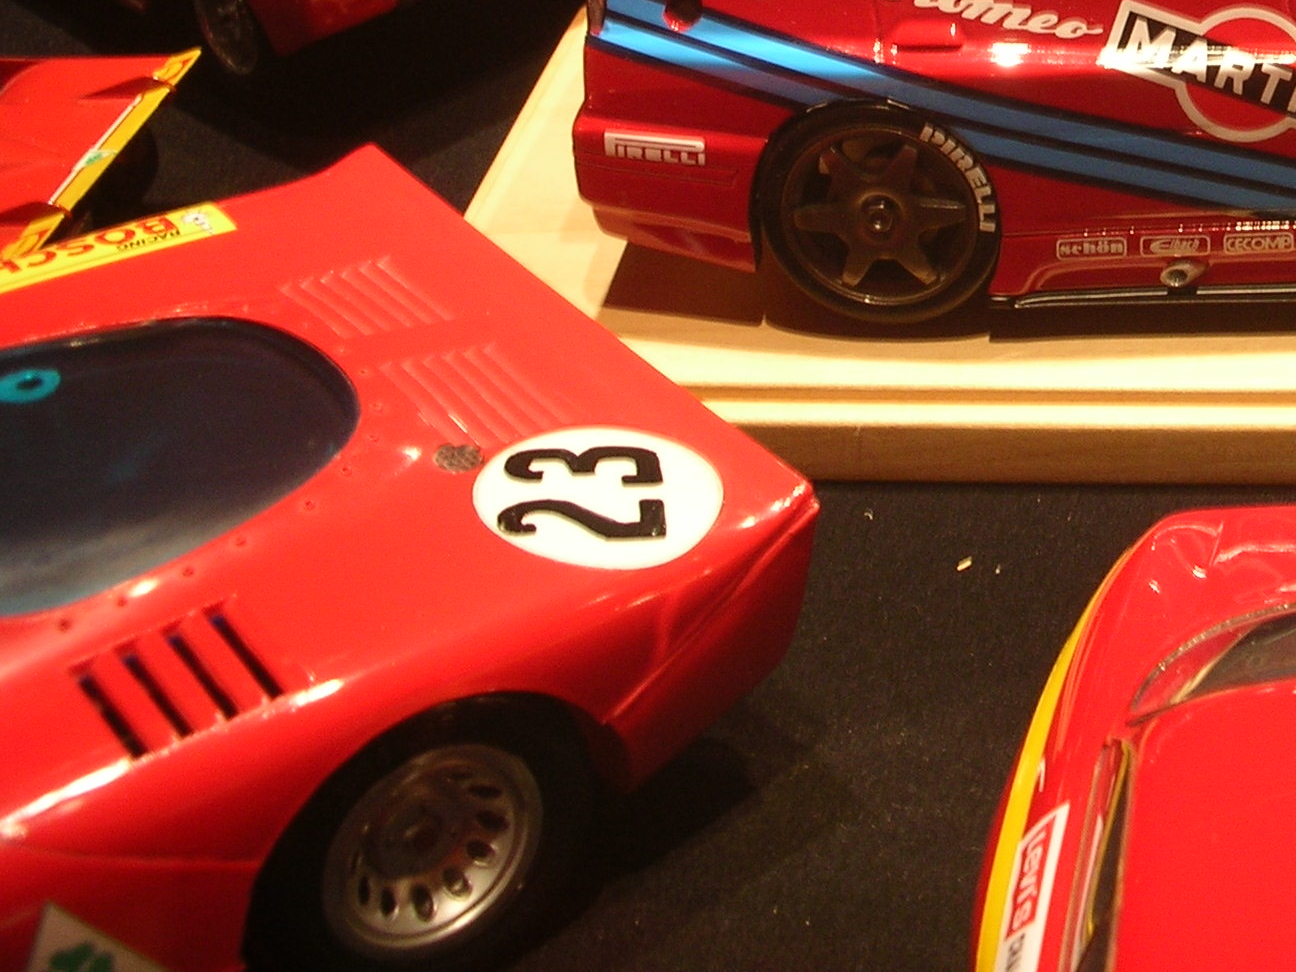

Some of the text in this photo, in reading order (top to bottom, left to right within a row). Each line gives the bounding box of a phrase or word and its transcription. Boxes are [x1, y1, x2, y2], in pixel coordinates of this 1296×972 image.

[604, 132, 706, 167] PIRELLI
[919, 122, 997, 233] PIRELLI
[497, 446, 667, 540] 23
